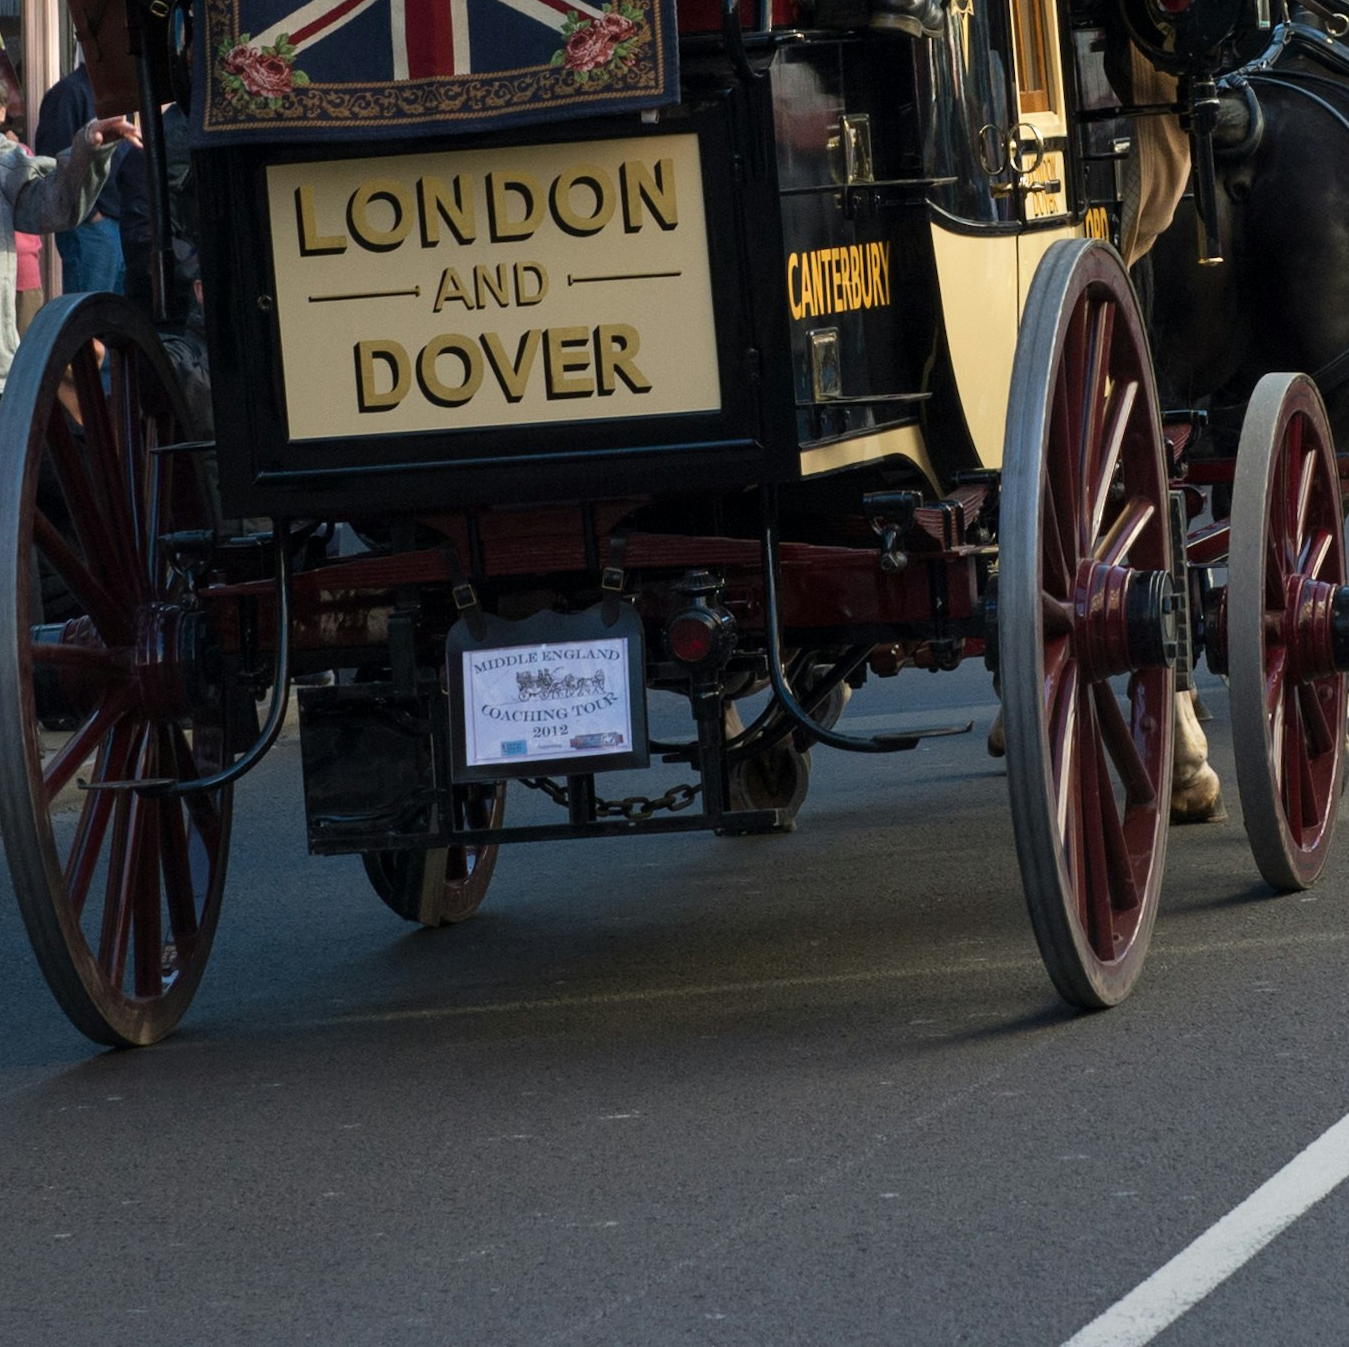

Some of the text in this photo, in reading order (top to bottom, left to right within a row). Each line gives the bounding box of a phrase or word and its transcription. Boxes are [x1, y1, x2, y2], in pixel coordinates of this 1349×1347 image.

[293, 157, 680, 257] LONDON
[432, 260, 550, 314] AND
[788, 241, 890, 320] CANTERBURY
[352, 322, 652, 413] DOVER
[474, 648, 620, 674] MIDDLE ENGLAND
[481, 691, 619, 722] COACHING TOUR
[533, 724, 569, 738] 2012
